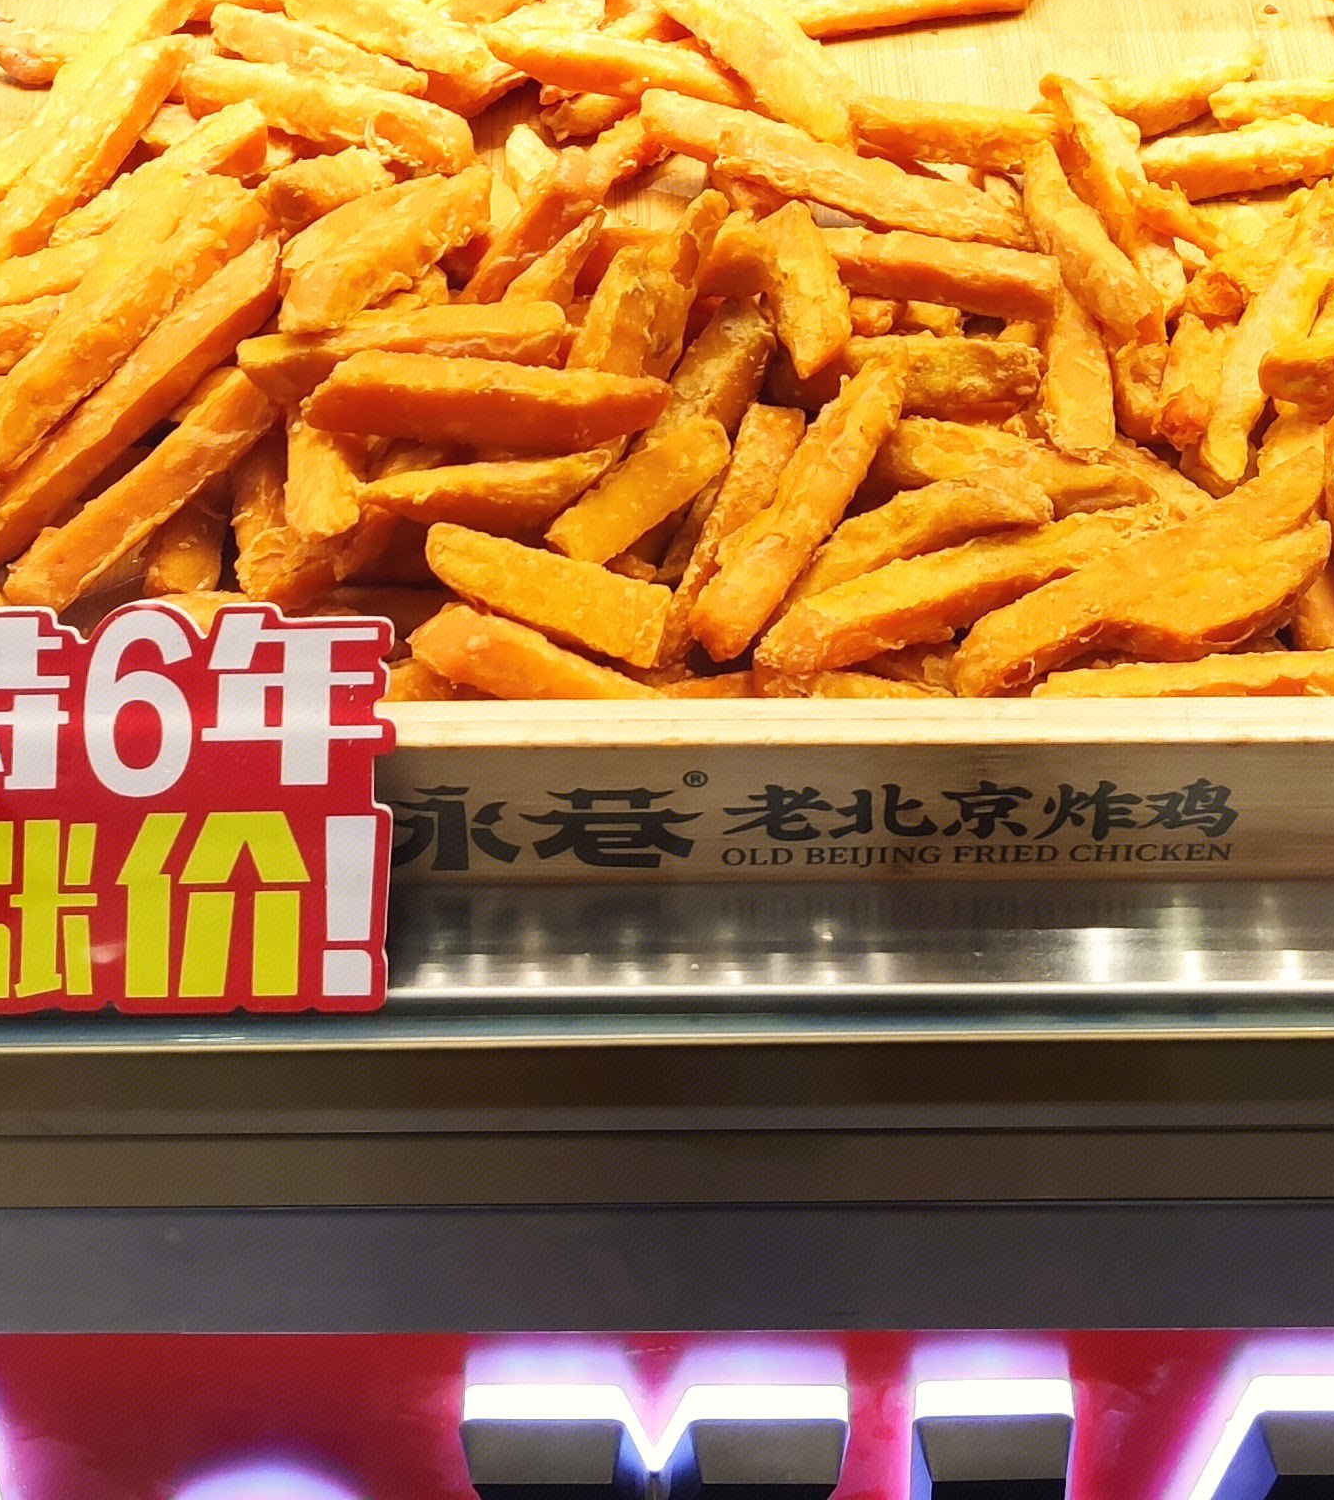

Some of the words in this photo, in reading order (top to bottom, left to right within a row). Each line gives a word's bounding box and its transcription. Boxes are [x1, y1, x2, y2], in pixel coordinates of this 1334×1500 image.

[721, 777, 1240, 842] 老北京炸鸡
[721, 847, 794, 867] OLD
[805, 845, 942, 869] BEIJING
[952, 844, 1059, 865] FRIED
[1069, 842, 1234, 863] CHICKEN
